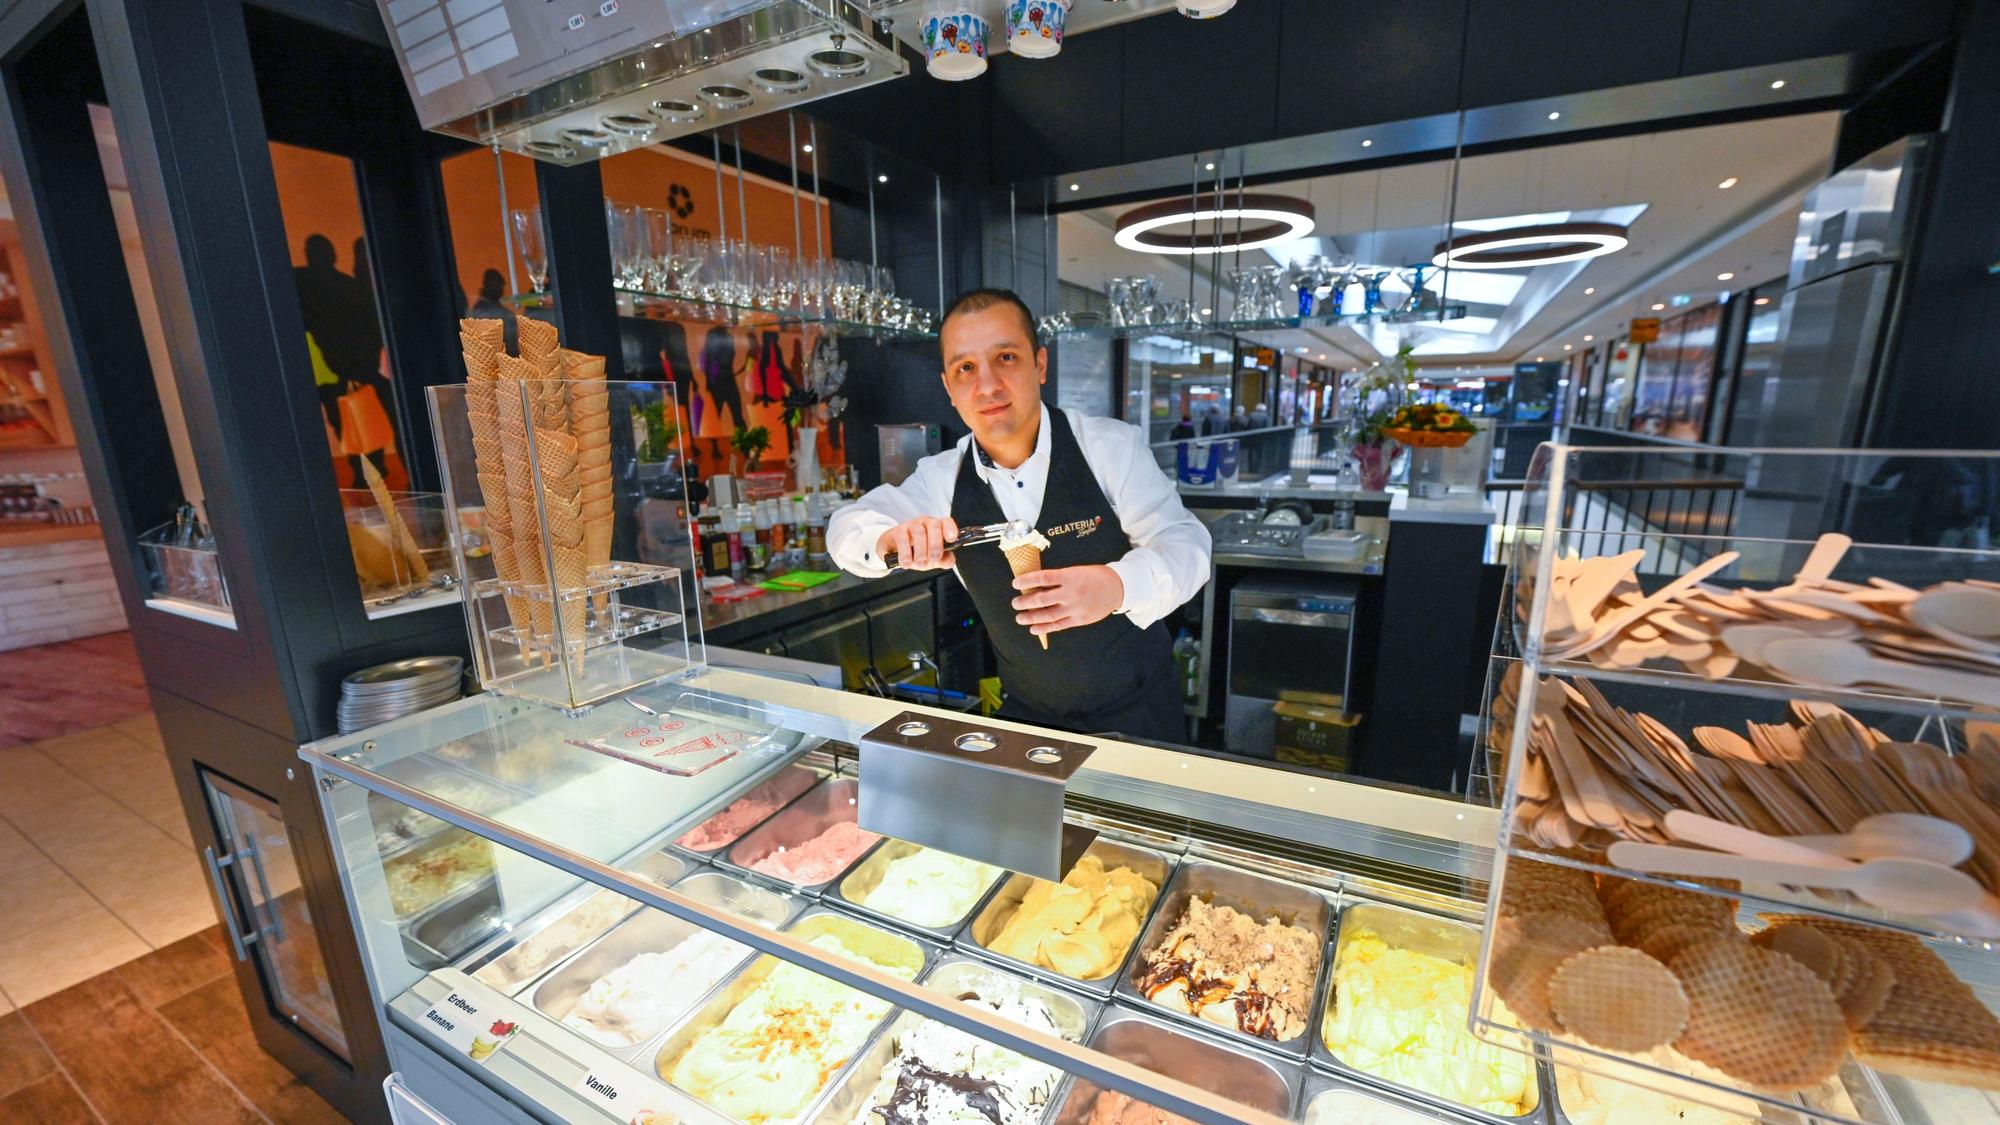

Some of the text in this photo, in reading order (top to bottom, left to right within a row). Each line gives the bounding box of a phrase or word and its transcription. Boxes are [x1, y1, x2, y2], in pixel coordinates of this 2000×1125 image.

[1047, 518, 1096, 536] GELATERIA
[447, 993, 478, 1015] Erdbeer
[426, 1009, 455, 1031] Banane
[585, 1075, 618, 1100] Vanille
